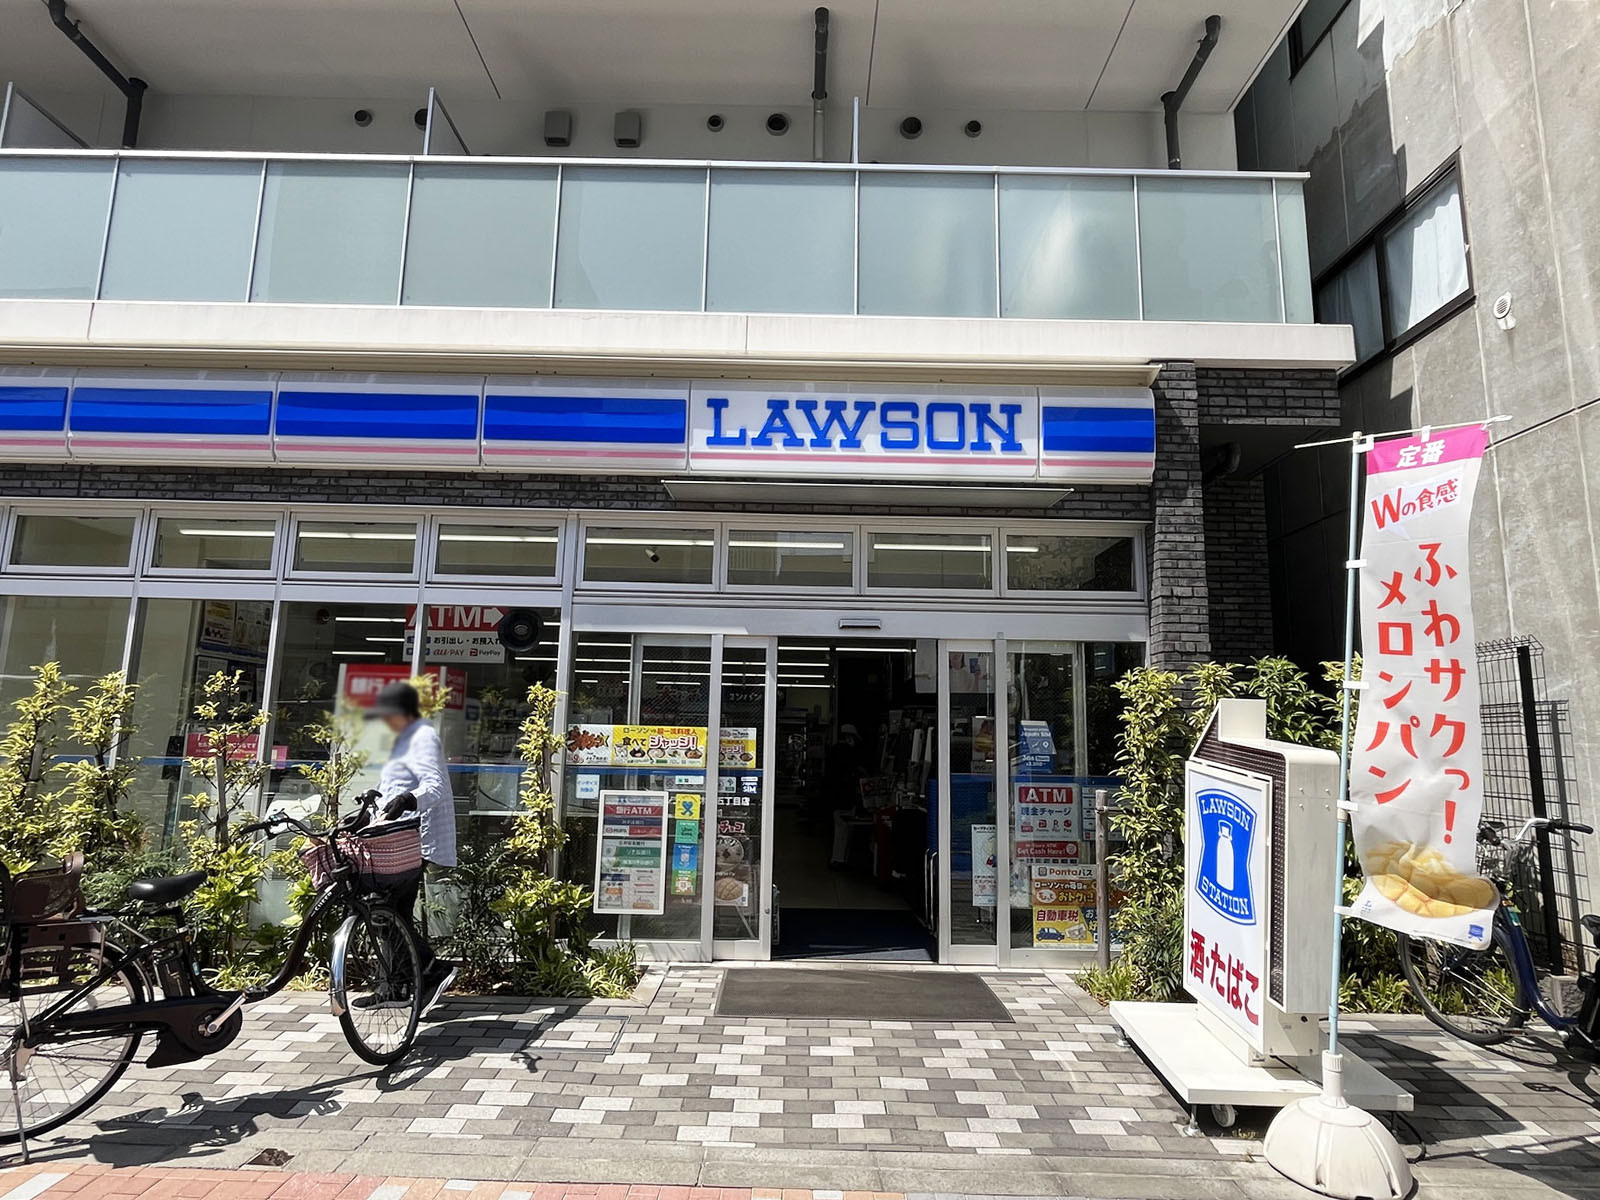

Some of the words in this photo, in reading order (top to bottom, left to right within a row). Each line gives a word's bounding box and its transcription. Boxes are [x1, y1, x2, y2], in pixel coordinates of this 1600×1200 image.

[705, 397, 1023, 452] LAWSON
[1396, 439, 1445, 468] 定番
[1371, 478, 1459, 530] Wの食感
[450, 649, 464, 657] PAY
[479, 649, 501, 657] PayPay
[1365, 571, 1422, 806] メロンパン
[1021, 807, 1072, 815] 現金チャージ
[1026, 788, 1066, 803] ATM
[1201, 796, 1250, 832] LAWSON
[1201, 875, 1250, 915] STATION
[1036, 909, 1079, 922] 自動車税
[1190, 928, 1259, 1026] 酒・たばこ
